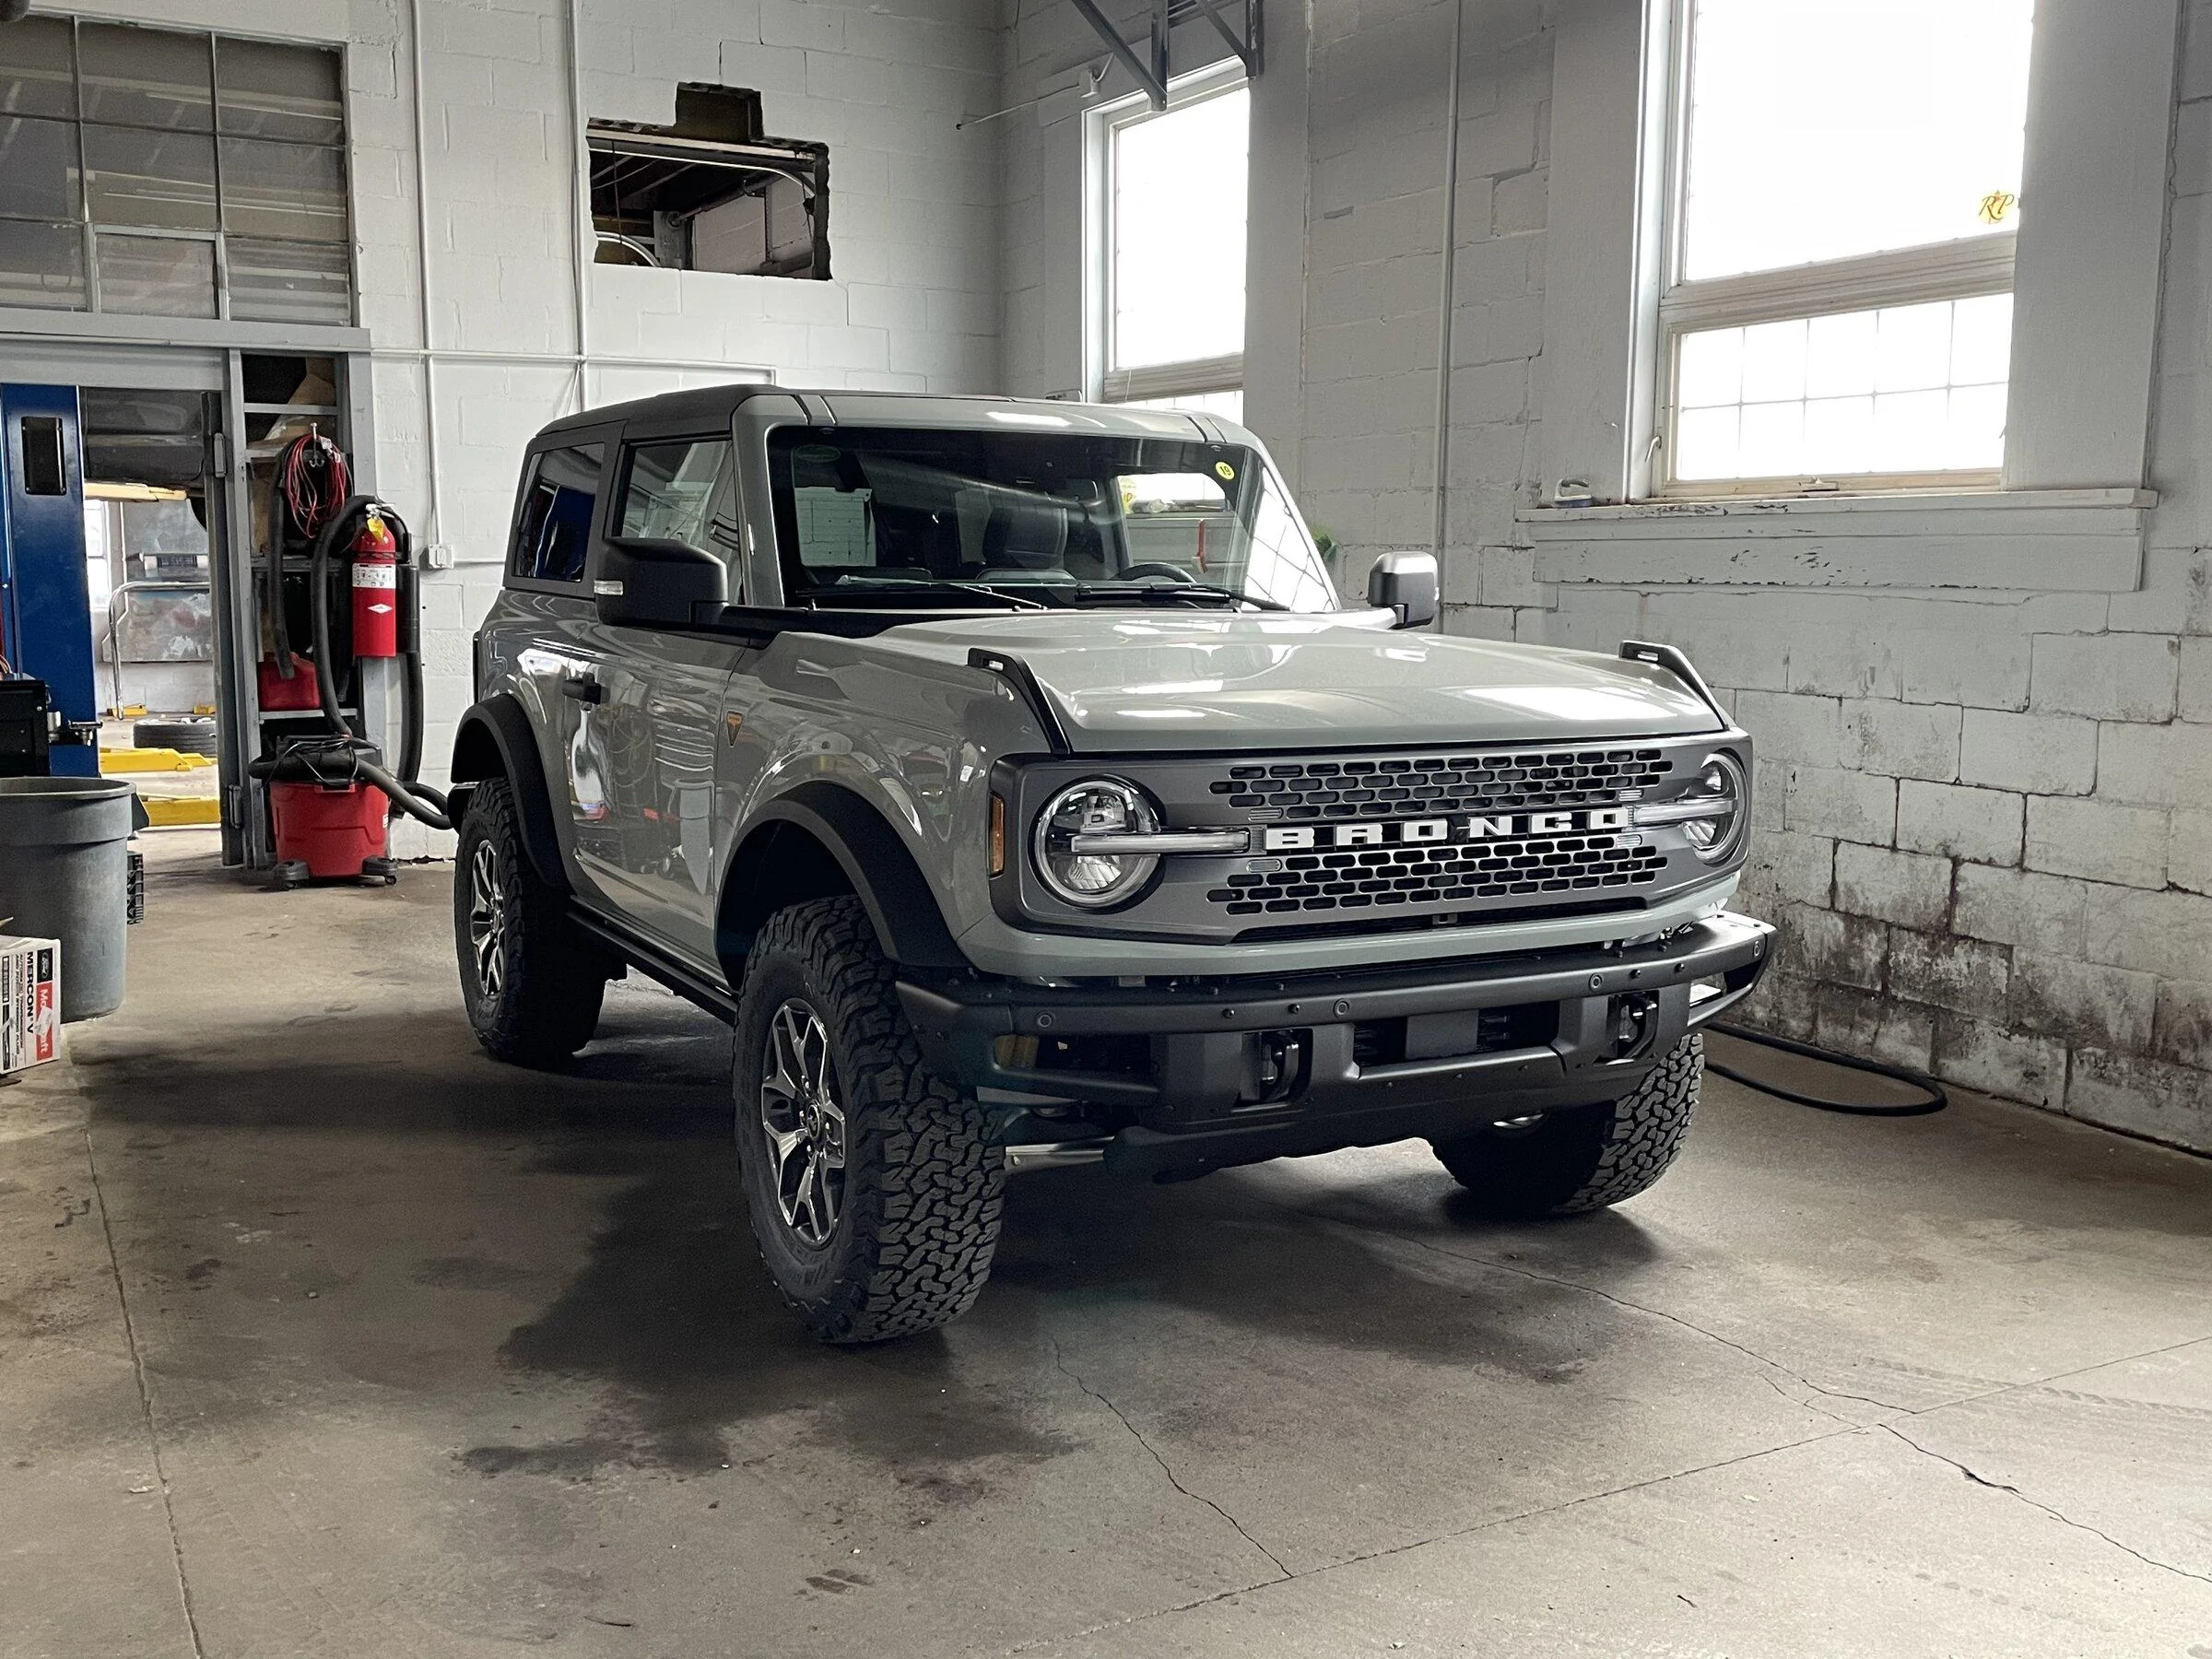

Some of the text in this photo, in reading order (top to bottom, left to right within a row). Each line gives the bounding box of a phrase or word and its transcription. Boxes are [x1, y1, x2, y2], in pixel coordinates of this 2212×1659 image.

[1219, 465, 1232, 477] 19
[1265, 806, 1629, 850] BRONCO
[27, 1024, 34, 1034] V
[40, 989, 49, 1053] Moaft
